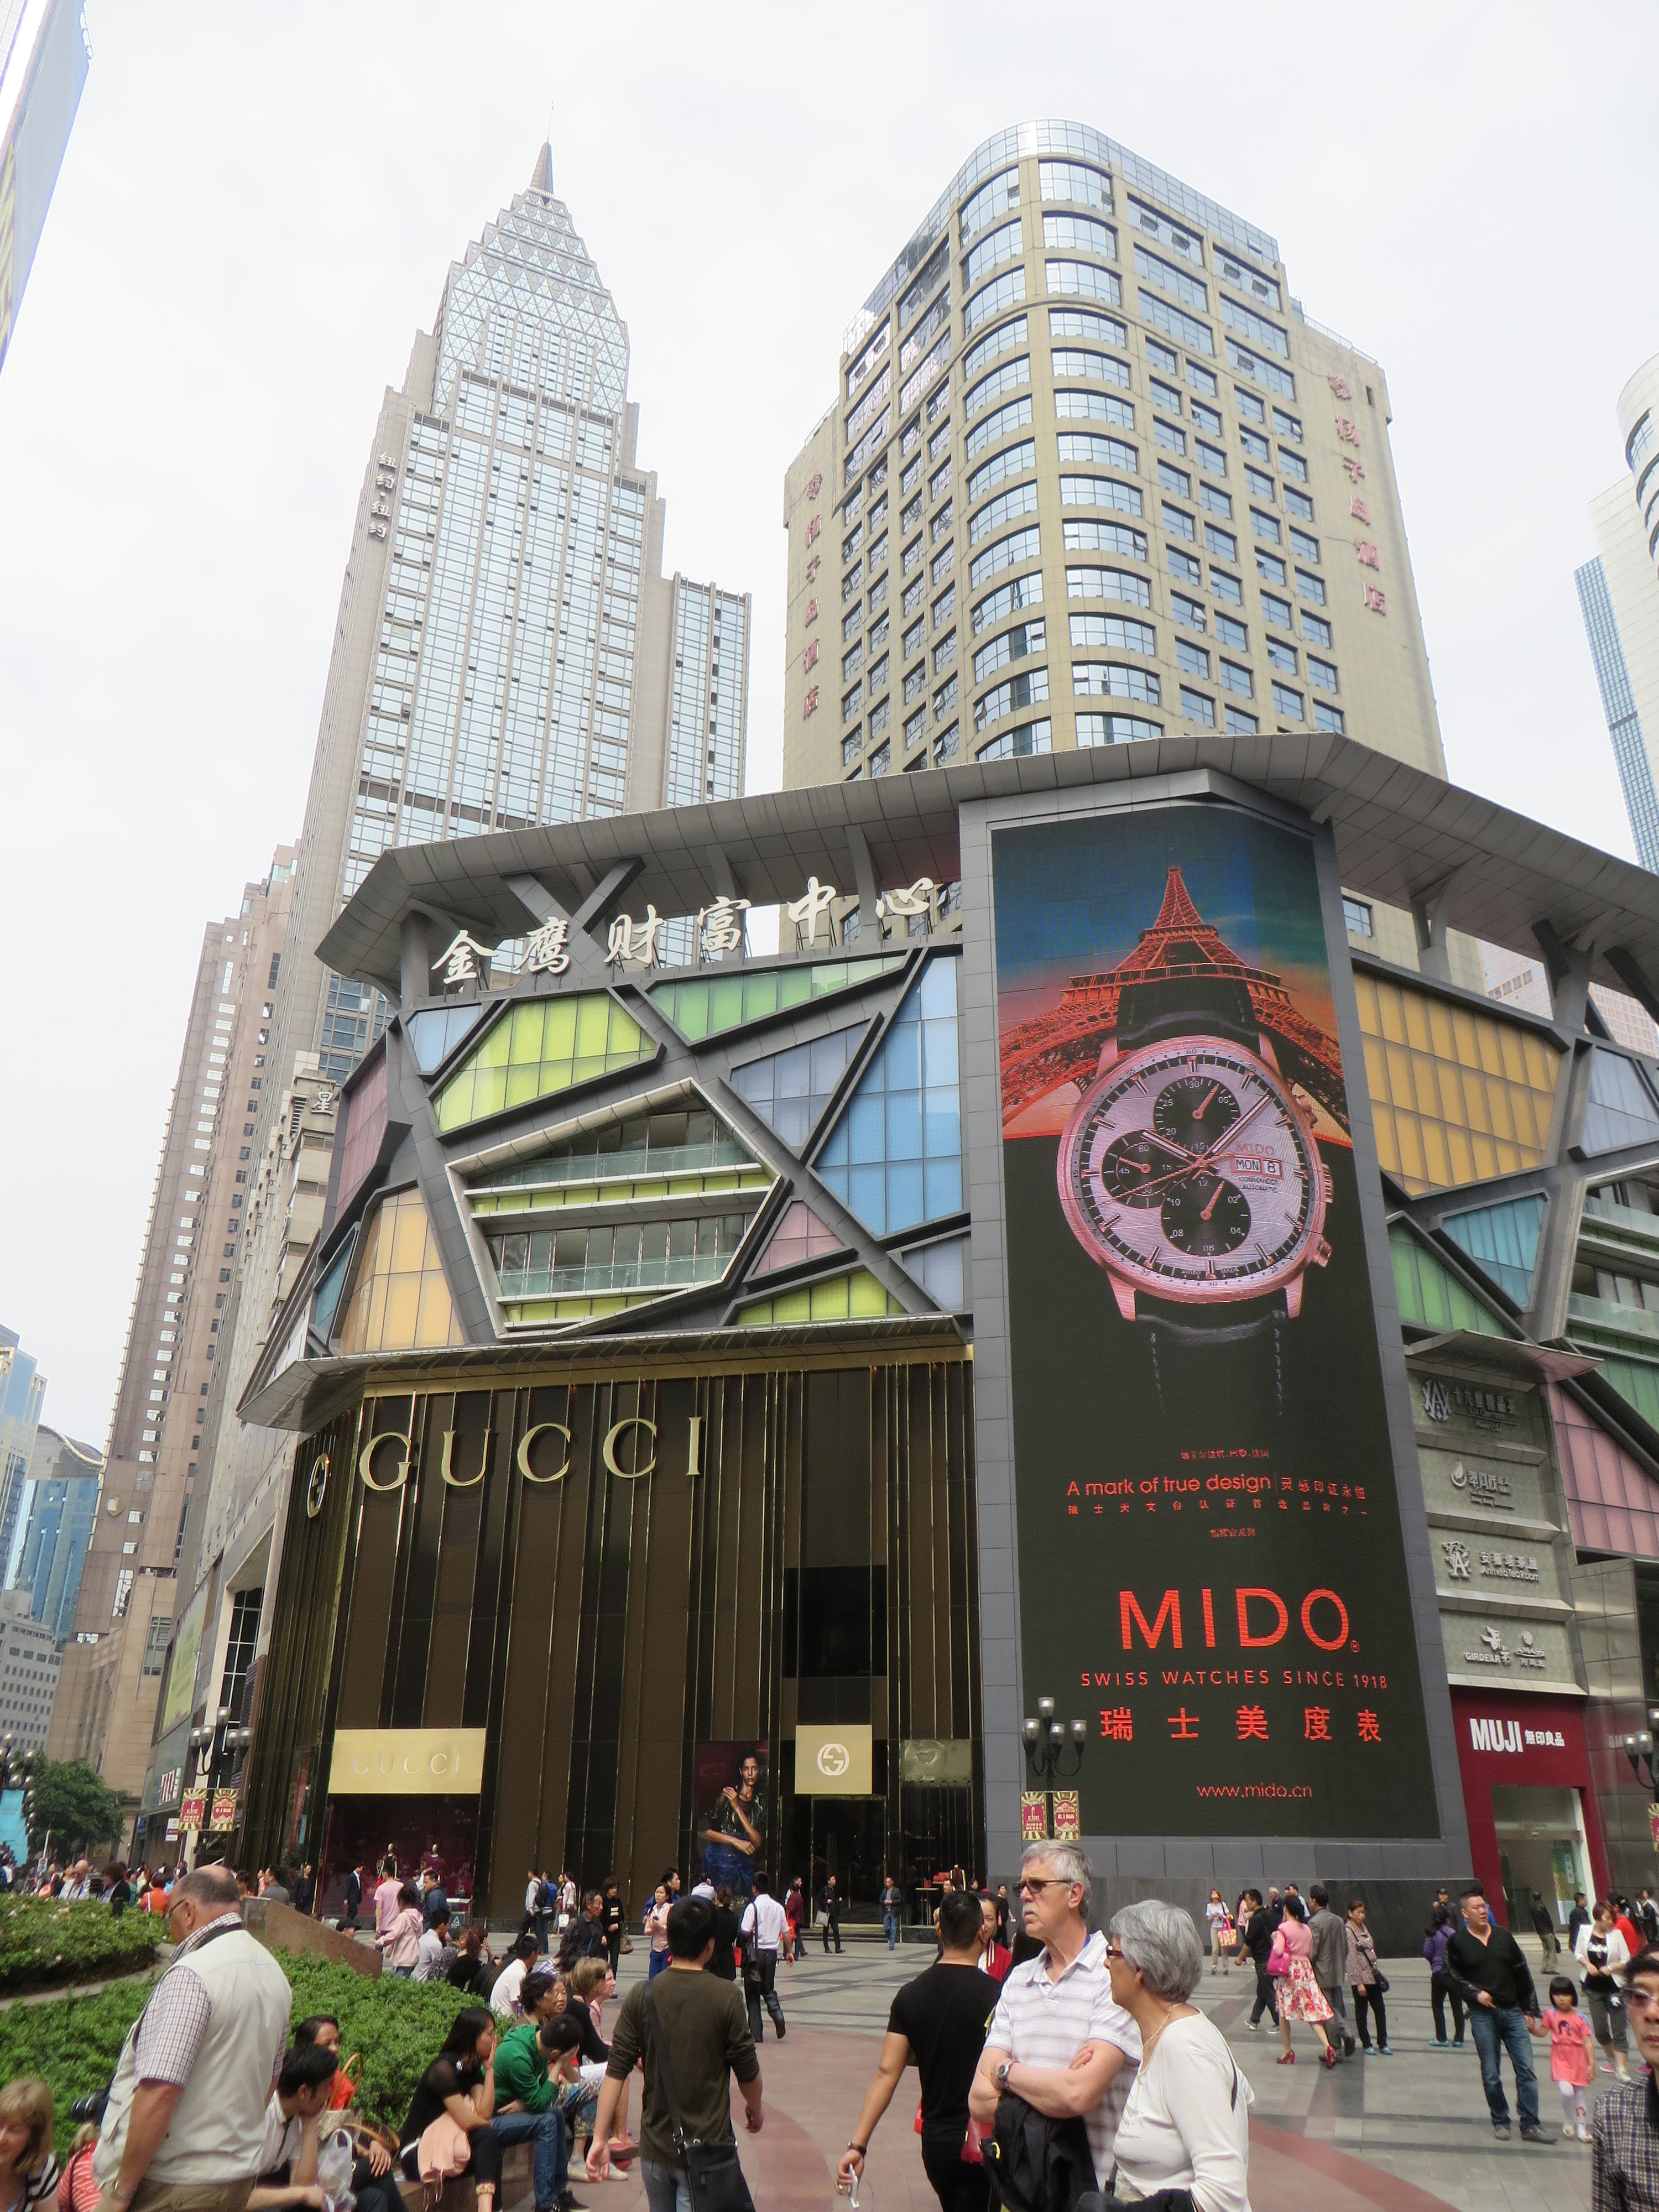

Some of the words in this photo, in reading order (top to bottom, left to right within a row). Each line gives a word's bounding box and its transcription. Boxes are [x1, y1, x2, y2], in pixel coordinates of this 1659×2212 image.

[431, 876, 933, 984] 金鹰财富中心
[1236, 1142, 1274, 1156] MIDO
[1235, 1159, 1259, 1171] MON
[1267, 1162, 1276, 1173] 8
[359, 1416, 702, 1491] GUCCI
[1067, 1480, 1080, 1496] A
[1085, 1478, 1134, 1495] mark
[1140, 1476, 1159, 1494] of
[1163, 1475, 1201, 1493] true
[1206, 1473, 1271, 1494] design
[1119, 1588, 1349, 1651] MIDO
[1465, 1651, 1501, 1663] GIRDEAR
[1081, 1672, 1149, 1687] SWISS
[1162, 1670, 1270, 1685] WATCHES
[1284, 1670, 1345, 1688] SINCE
[1354, 1673, 1387, 1689] 1918
[1100, 1704, 1382, 1743] 瑞士美度表
[1469, 1718, 1524, 1752] MUJI
[1524, 1729, 1566, 1747] 無印良品
[352, 1753, 460, 1775] GUCCI
[1197, 1782, 1313, 1798] www.mido.cn
